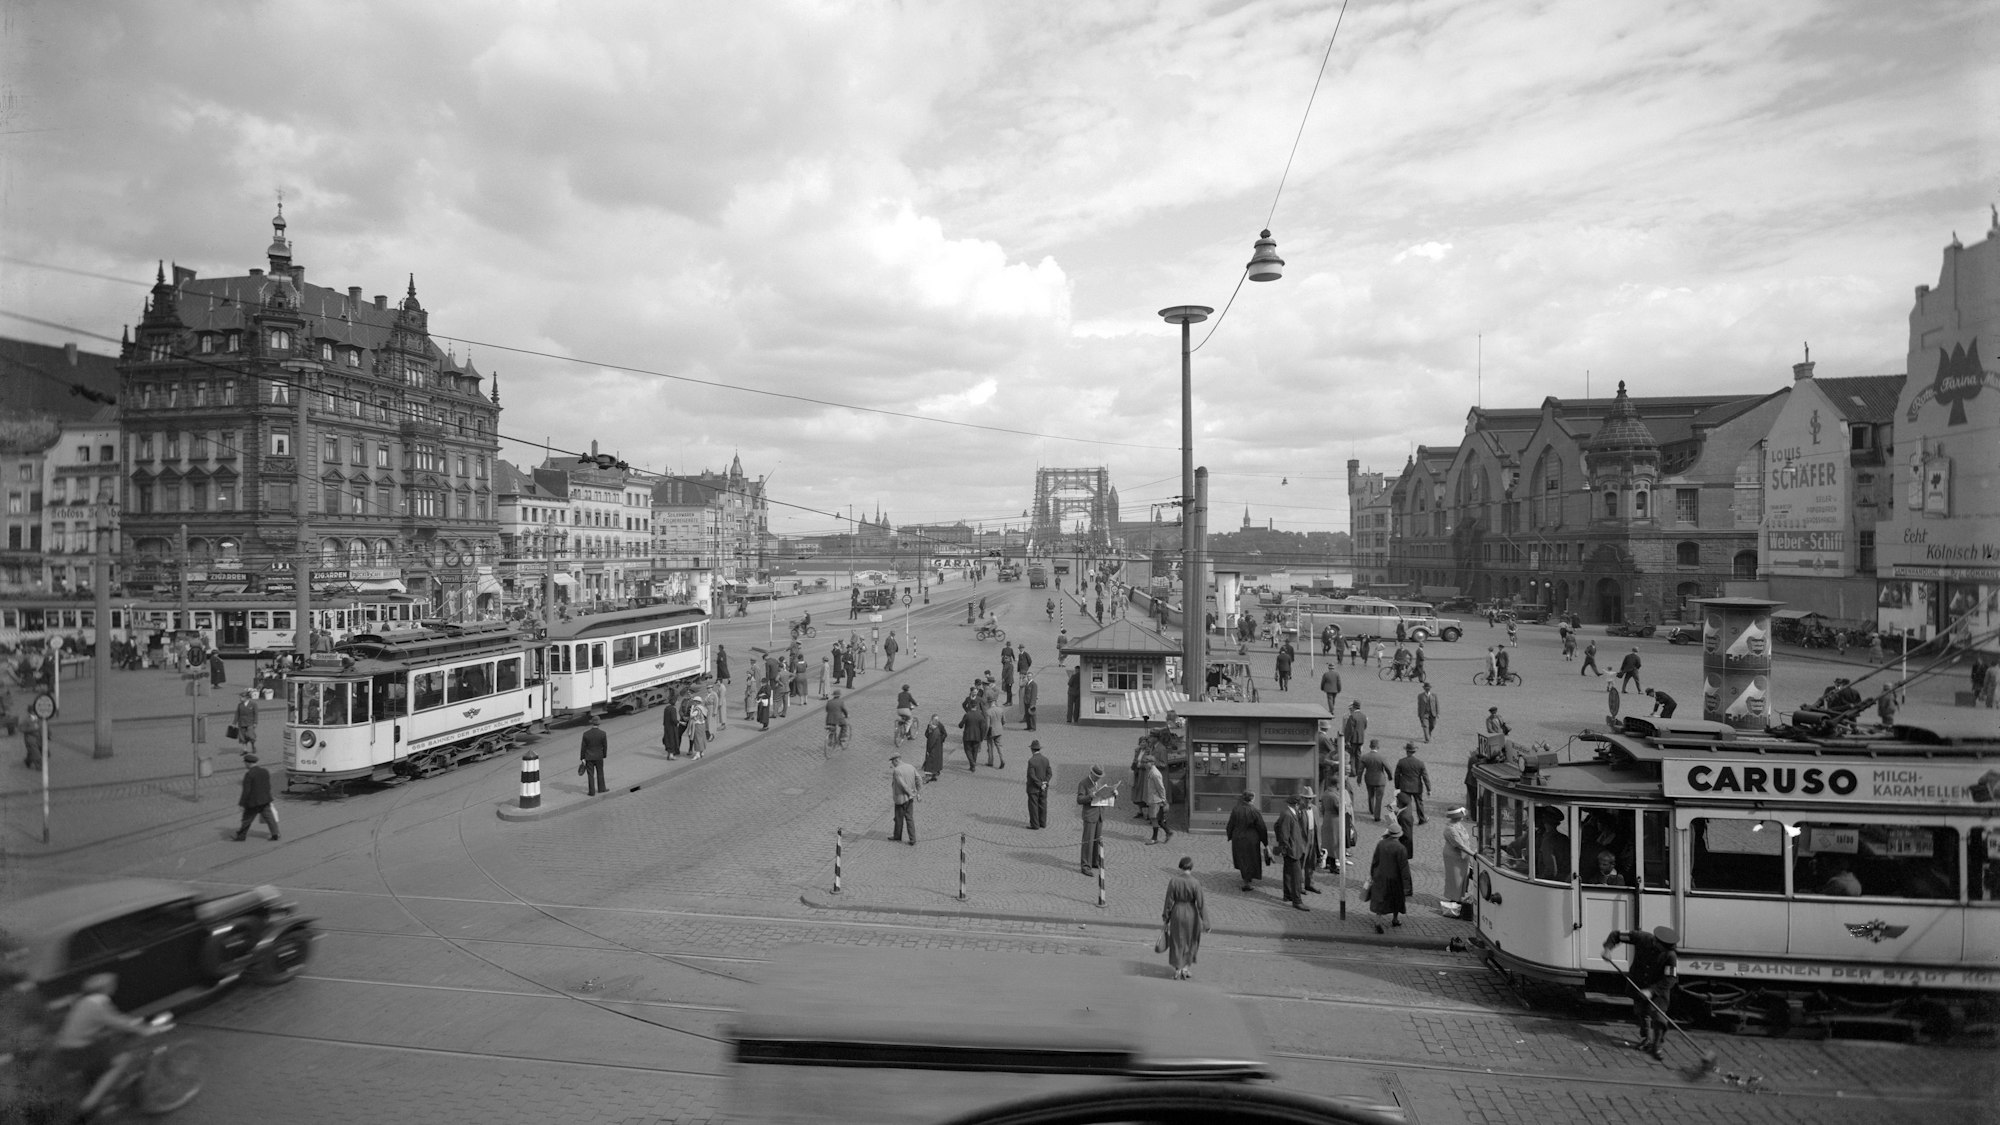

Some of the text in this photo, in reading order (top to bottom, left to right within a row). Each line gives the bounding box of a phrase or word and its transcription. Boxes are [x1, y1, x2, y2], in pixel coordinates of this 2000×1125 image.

[1940, 375, 1977, 393] Farina
[1771, 446, 1801, 463] LOUIS
[1771, 462, 1837, 490] SCHÄFER
[1769, 532, 1843, 550] Weber-Schiff
[1903, 527, 1928, 544] Echt
[1926, 543, 1978, 560] Kölnisch
[210, 573, 247, 581] ZIGARREN
[313, 571, 348, 579] ZIGARREN
[294, 655, 302, 665] 4
[428, 735, 455, 747] BAHNEN
[472, 725, 491, 734] STADT
[494, 720, 508, 728] KÖLN
[1687, 765, 1858, 796] CARUSO
[1873, 770, 1922, 784] MILCH-
[1873, 784, 1971, 800] KARAMELLEN
[1689, 960, 1726, 972] 475
[1737, 962, 1821, 977] BAHNEN
[1831, 966, 1872, 978] DER
[1882, 968, 1948, 982] STADT
